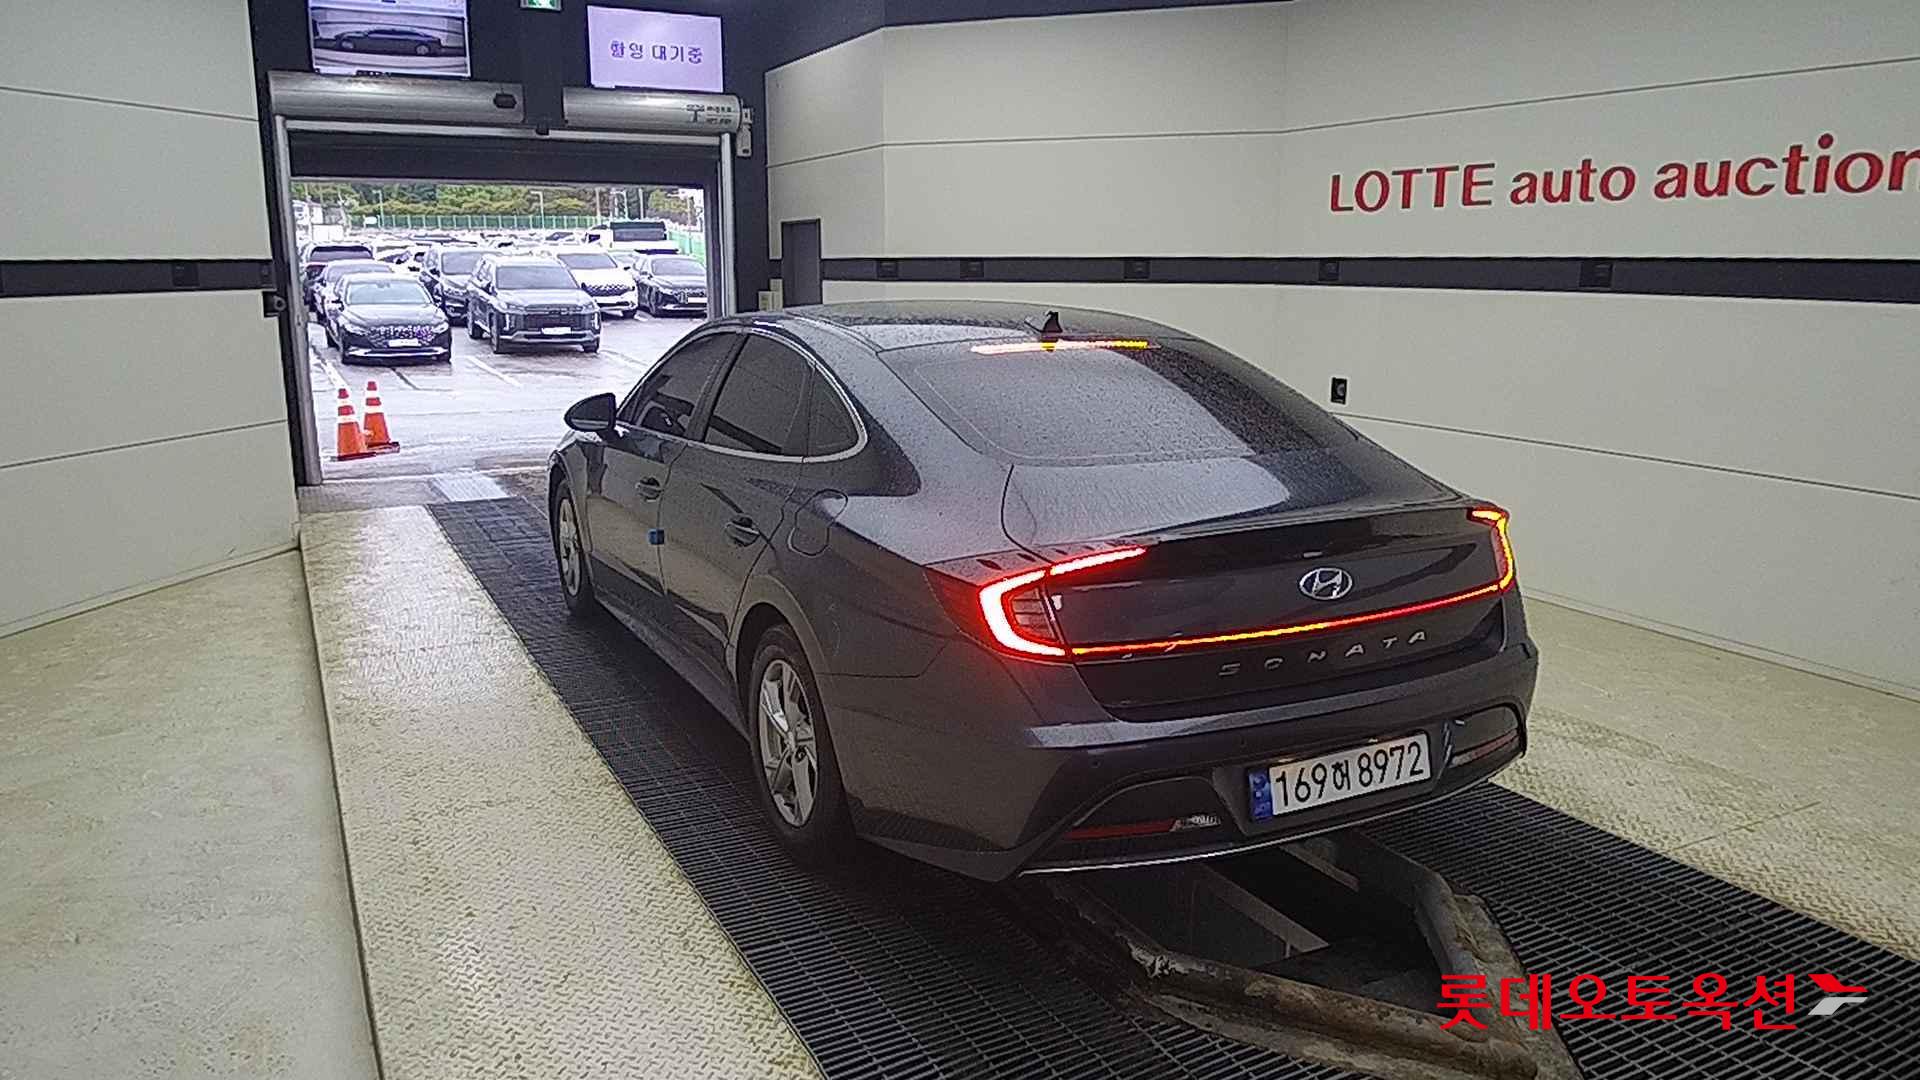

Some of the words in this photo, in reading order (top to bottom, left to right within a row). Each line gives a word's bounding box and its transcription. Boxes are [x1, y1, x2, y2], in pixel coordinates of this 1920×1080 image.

[1330, 163, 1495, 212] LOTTE
[1510, 159, 1636, 205] auto
[1218, 631, 1427, 677] SONATA
